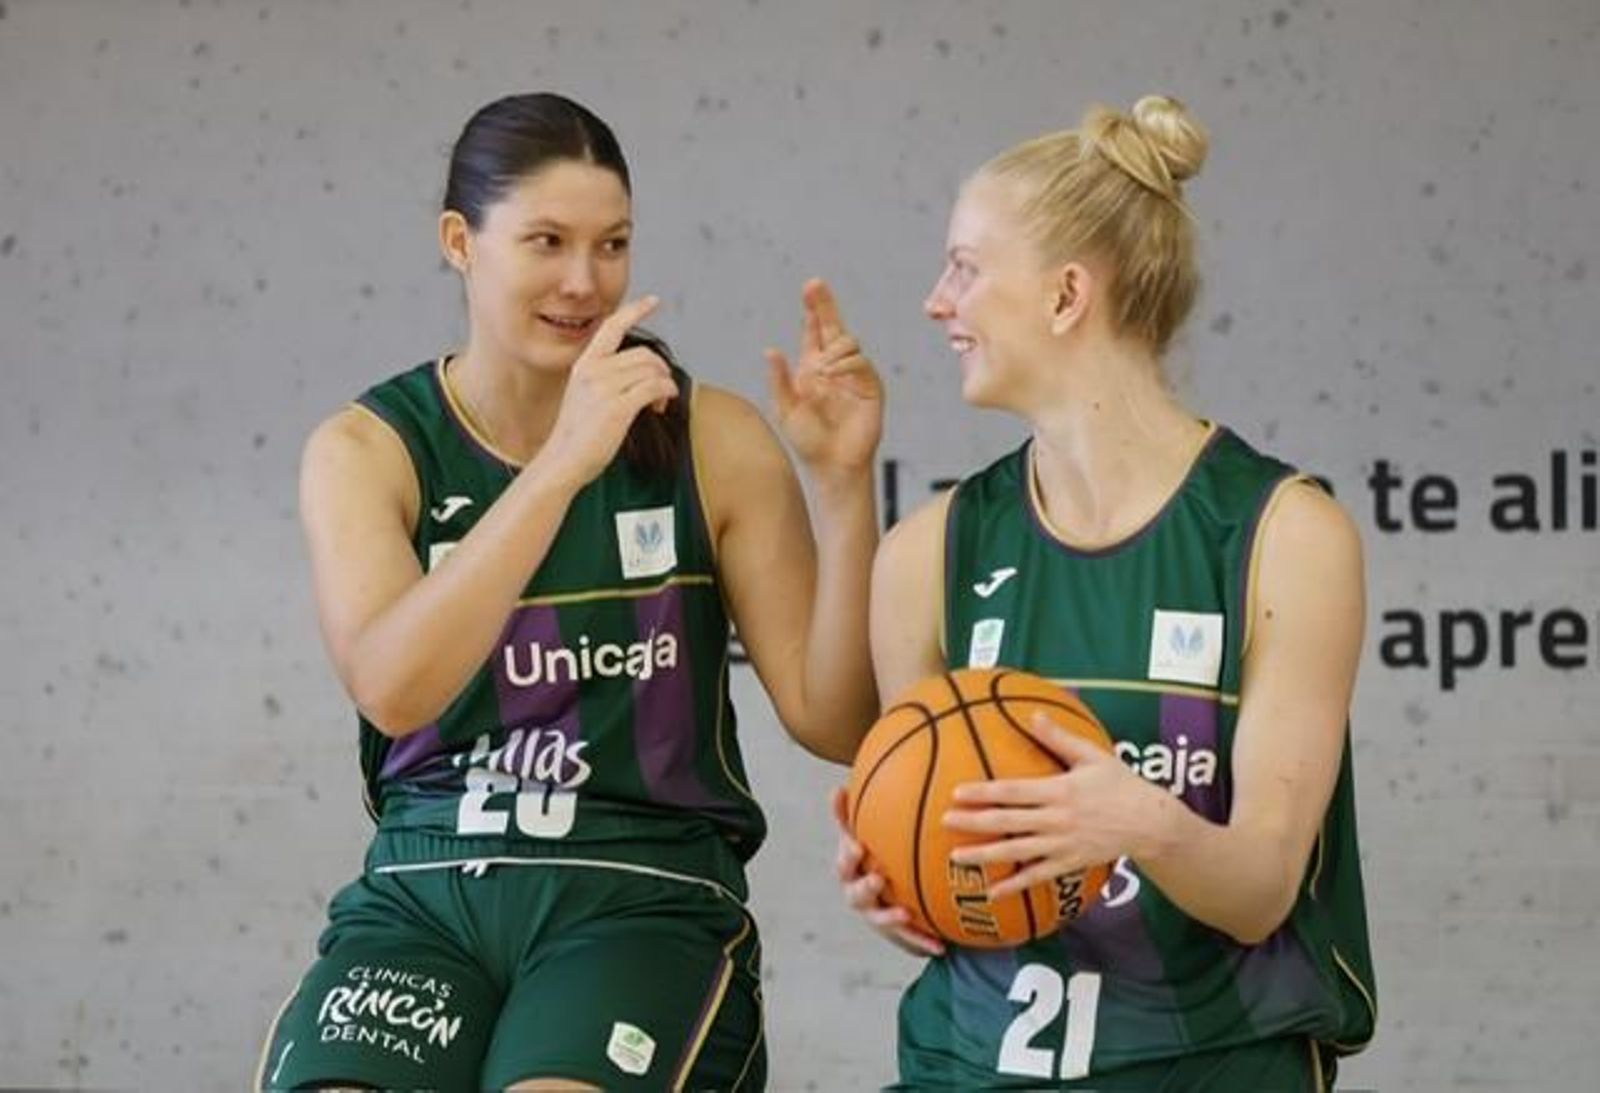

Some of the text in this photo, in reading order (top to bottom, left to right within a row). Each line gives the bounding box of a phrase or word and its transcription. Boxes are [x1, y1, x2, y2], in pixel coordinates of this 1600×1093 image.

[1368, 459, 1459, 533] te
[1490, 449, 1598, 533] ali
[1380, 609, 1589, 691] apre
[1113, 735, 1218, 796] caja
[347, 965, 453, 999] CLINICAS
[320, 1023, 426, 1064] DENTAL
[997, 963, 1102, 1080] 21
